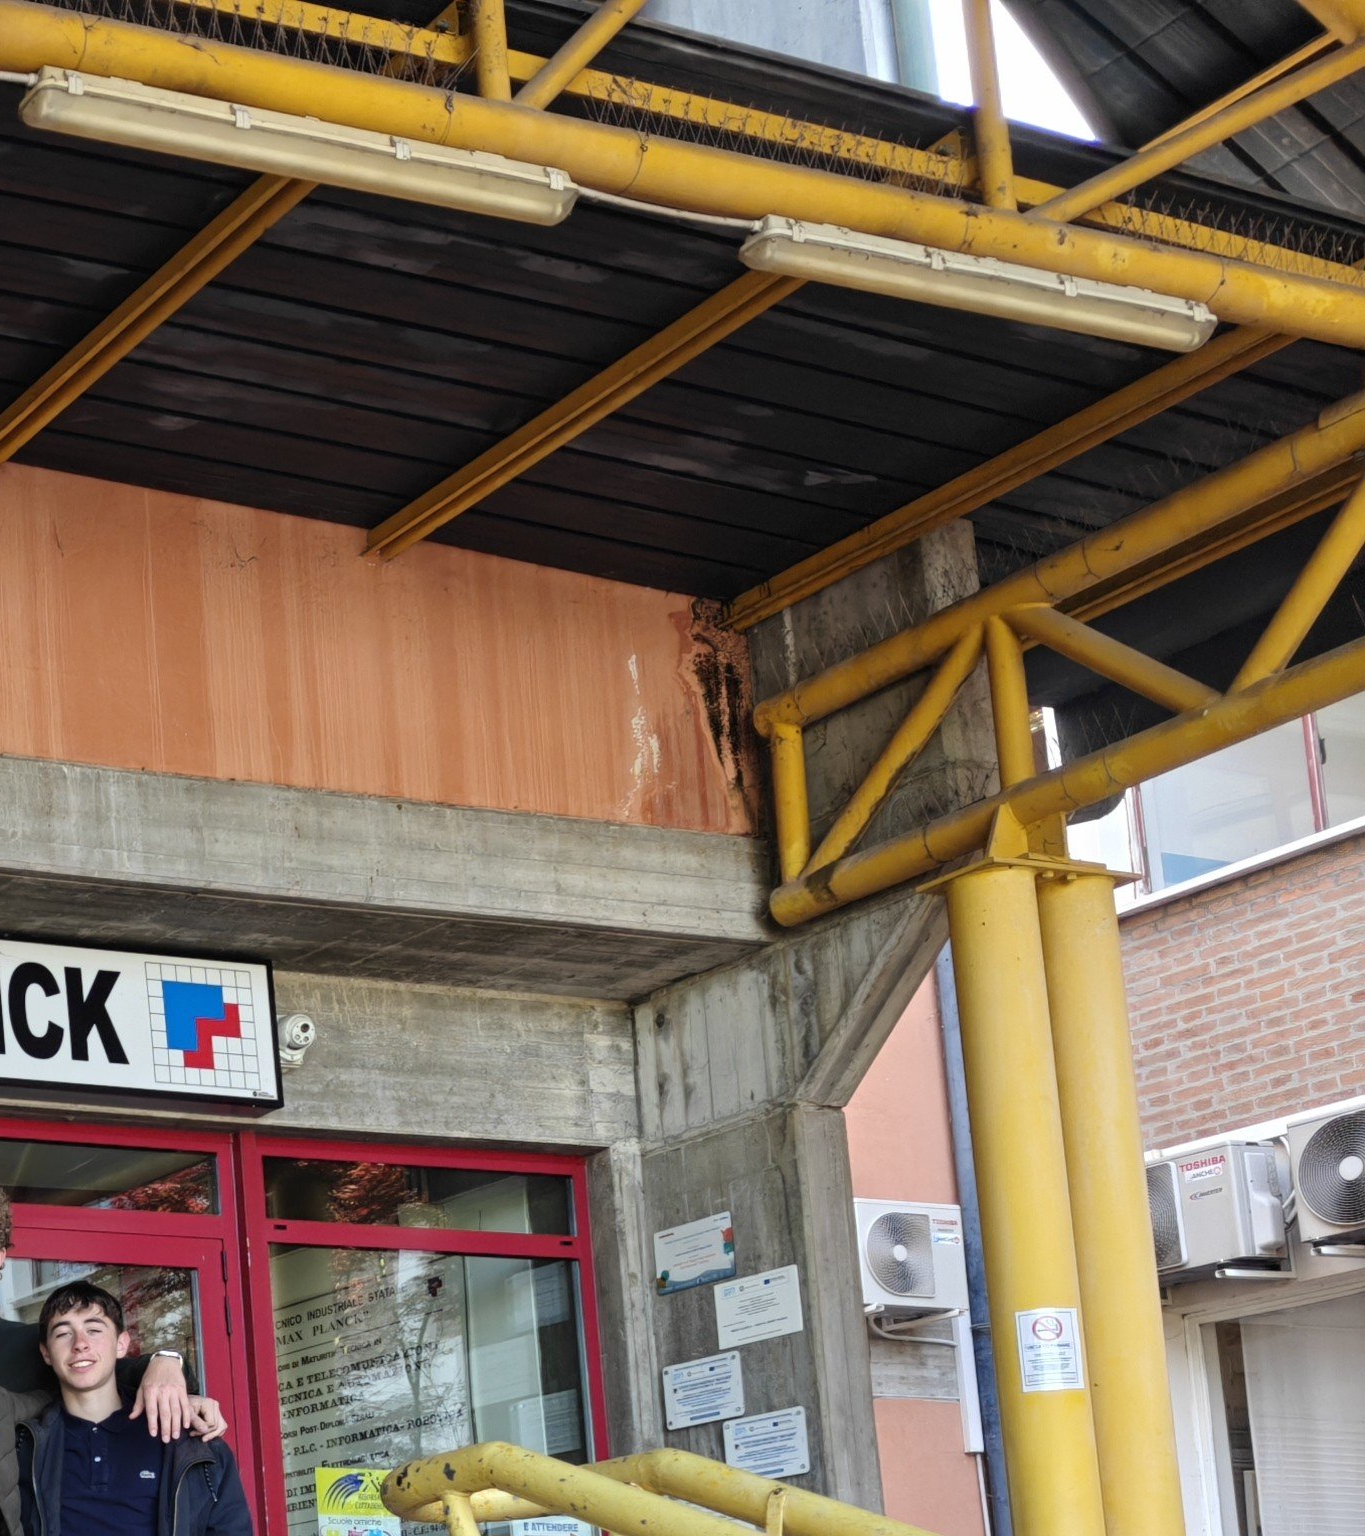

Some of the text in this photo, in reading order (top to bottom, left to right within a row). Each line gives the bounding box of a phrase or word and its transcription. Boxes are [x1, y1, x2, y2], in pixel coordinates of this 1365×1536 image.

[1179, 1155, 1226, 1172] TOSHIBA
[275, 1315, 302, 1331] CNICO
[306, 1296, 364, 1322] INDUSTRIALE
[276, 1330, 303, 1345] MAX
[280, 1388, 324, 1406] ECNICA
[283, 1391, 364, 1418] NFORMATICA
[531, 1522, 579, 1532] ATTENDERE
